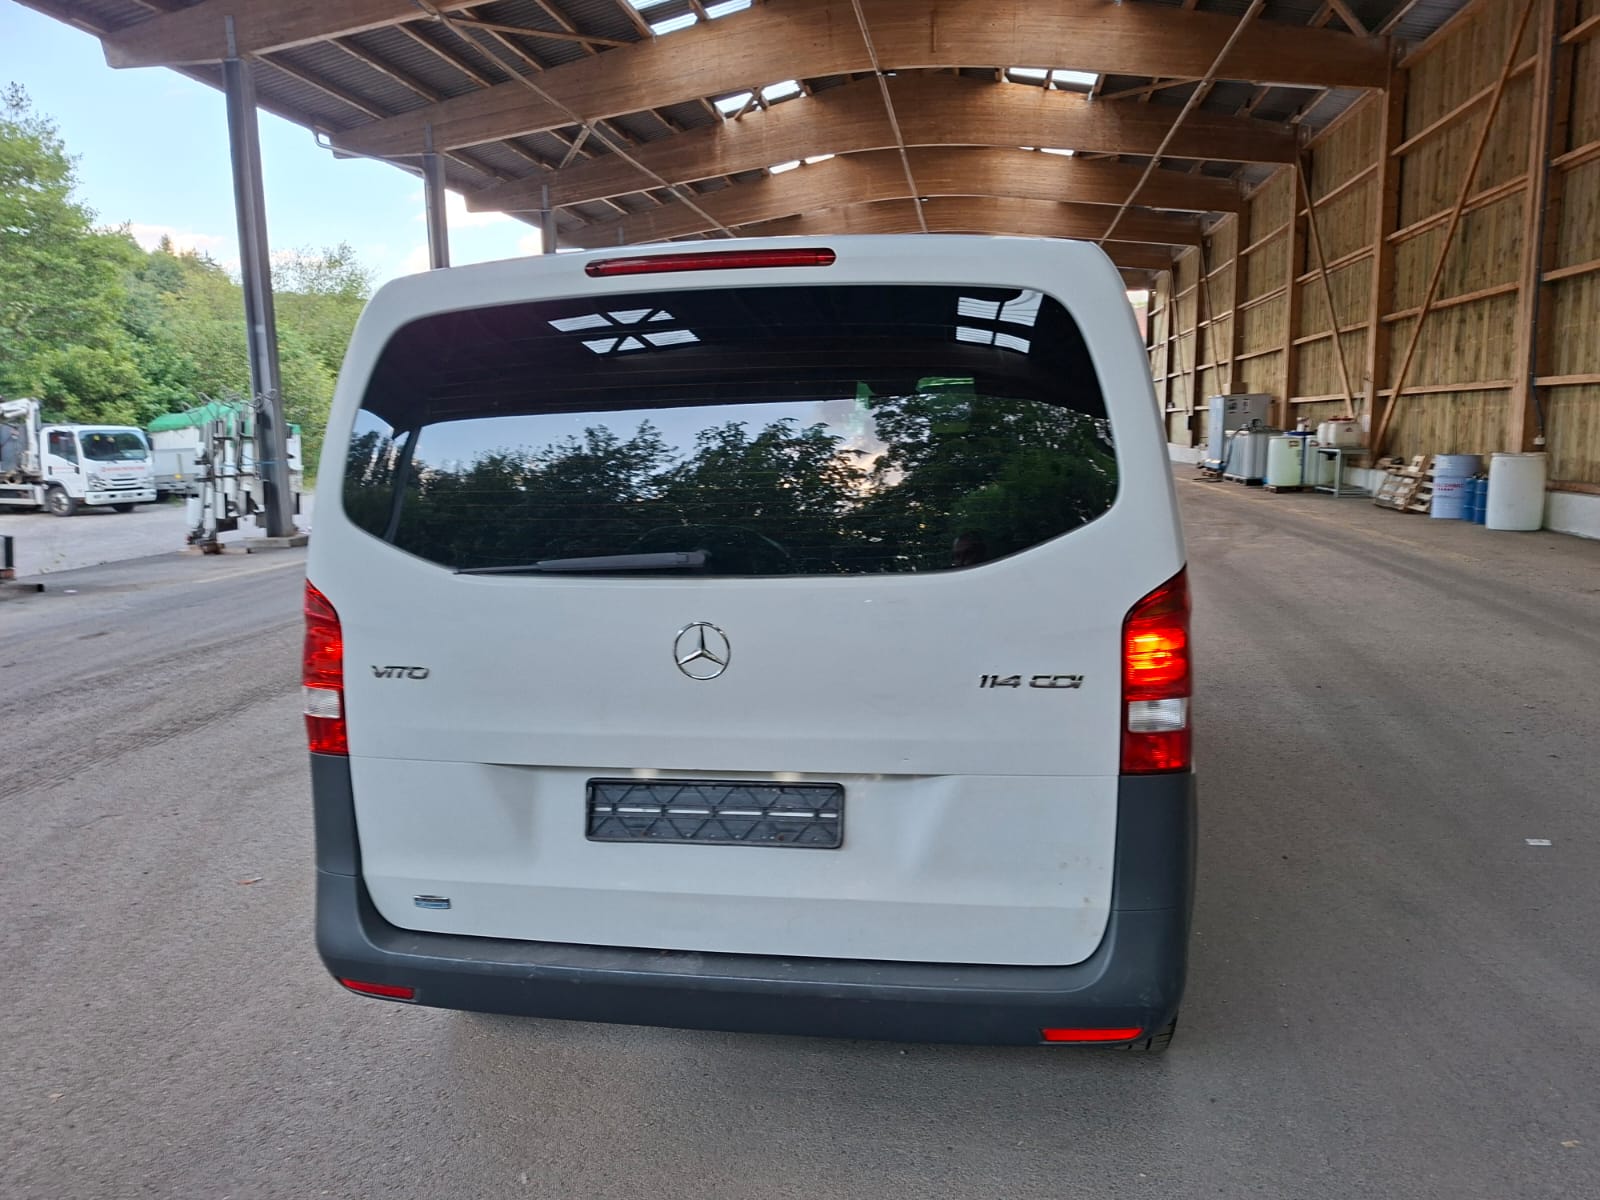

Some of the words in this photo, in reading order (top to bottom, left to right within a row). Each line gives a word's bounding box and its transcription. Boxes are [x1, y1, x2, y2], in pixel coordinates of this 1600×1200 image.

[371, 665, 430, 680] VITO
[979, 674, 1022, 689] 114
[1029, 674, 1084, 689] CDI
